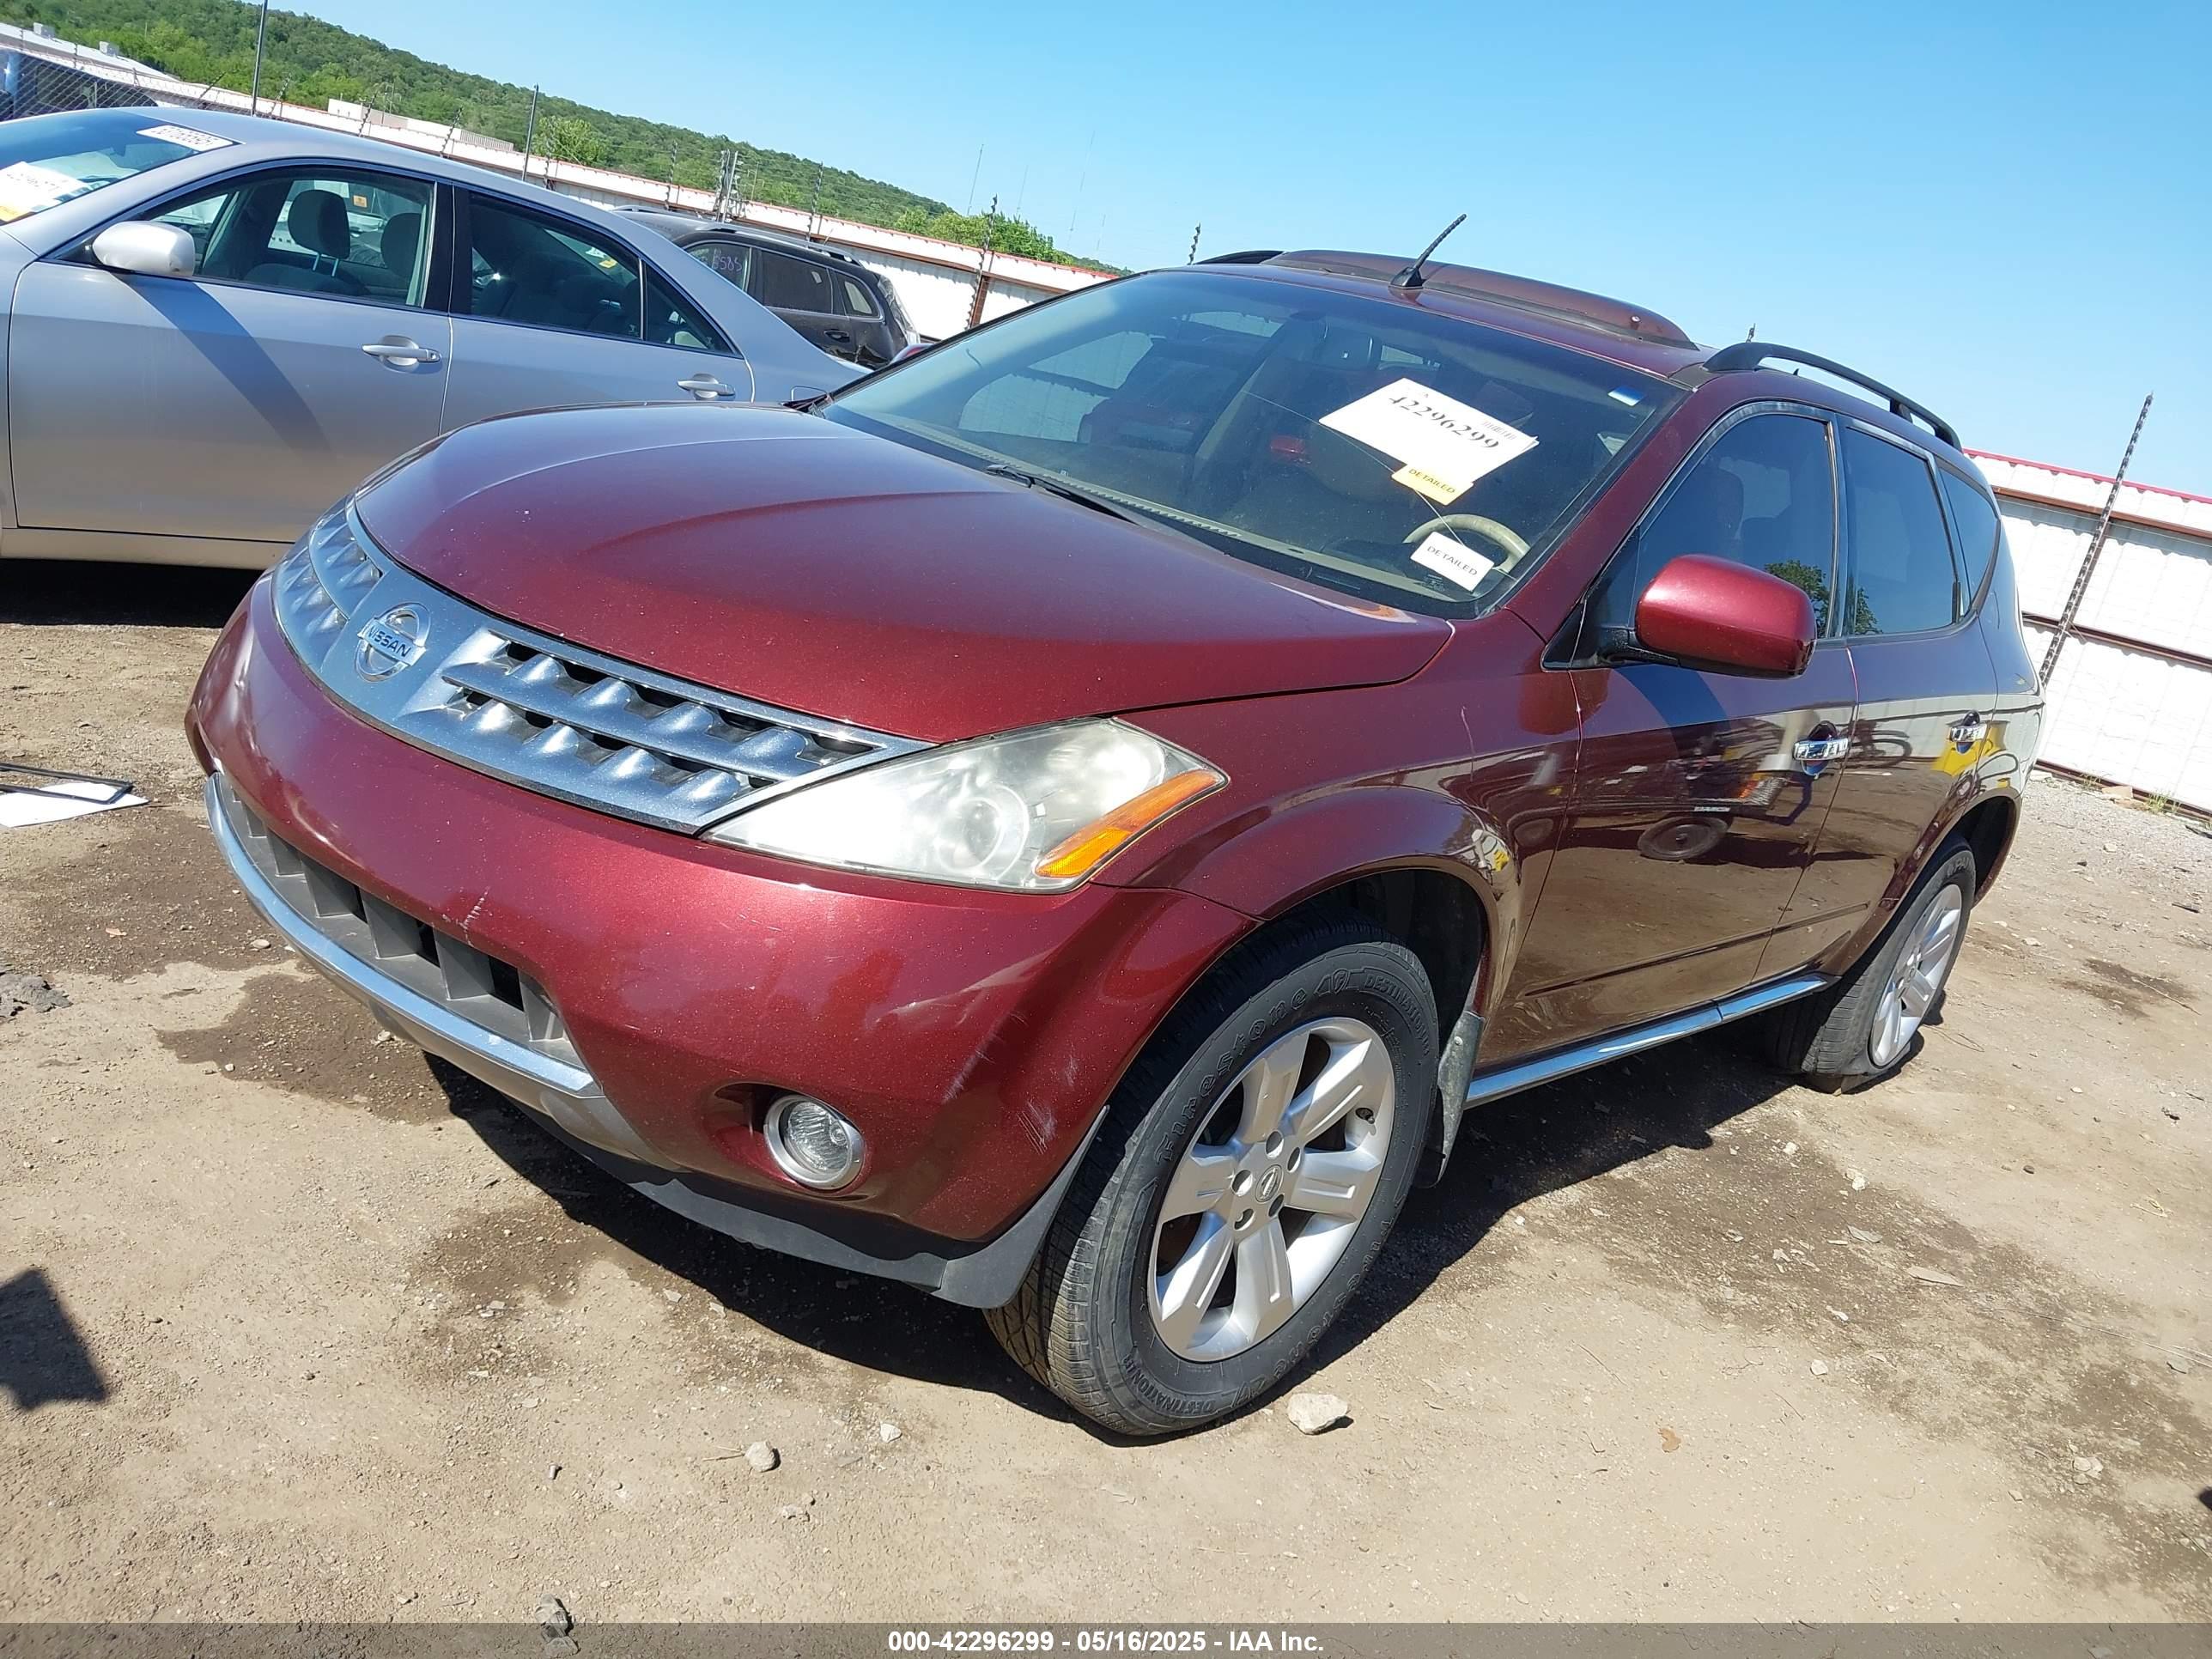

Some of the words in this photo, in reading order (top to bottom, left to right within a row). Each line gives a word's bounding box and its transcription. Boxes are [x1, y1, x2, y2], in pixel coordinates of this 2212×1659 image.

[1389, 396, 1500, 450] 42296299
[1407, 467, 1456, 495] DETAILED
[1426, 544, 1479, 577] DETAILED
[367, 625, 413, 658] NISSAN
[1155, 988, 1308, 1165] Firestone
[1130, 1366, 1215, 1416] DESTINATION
